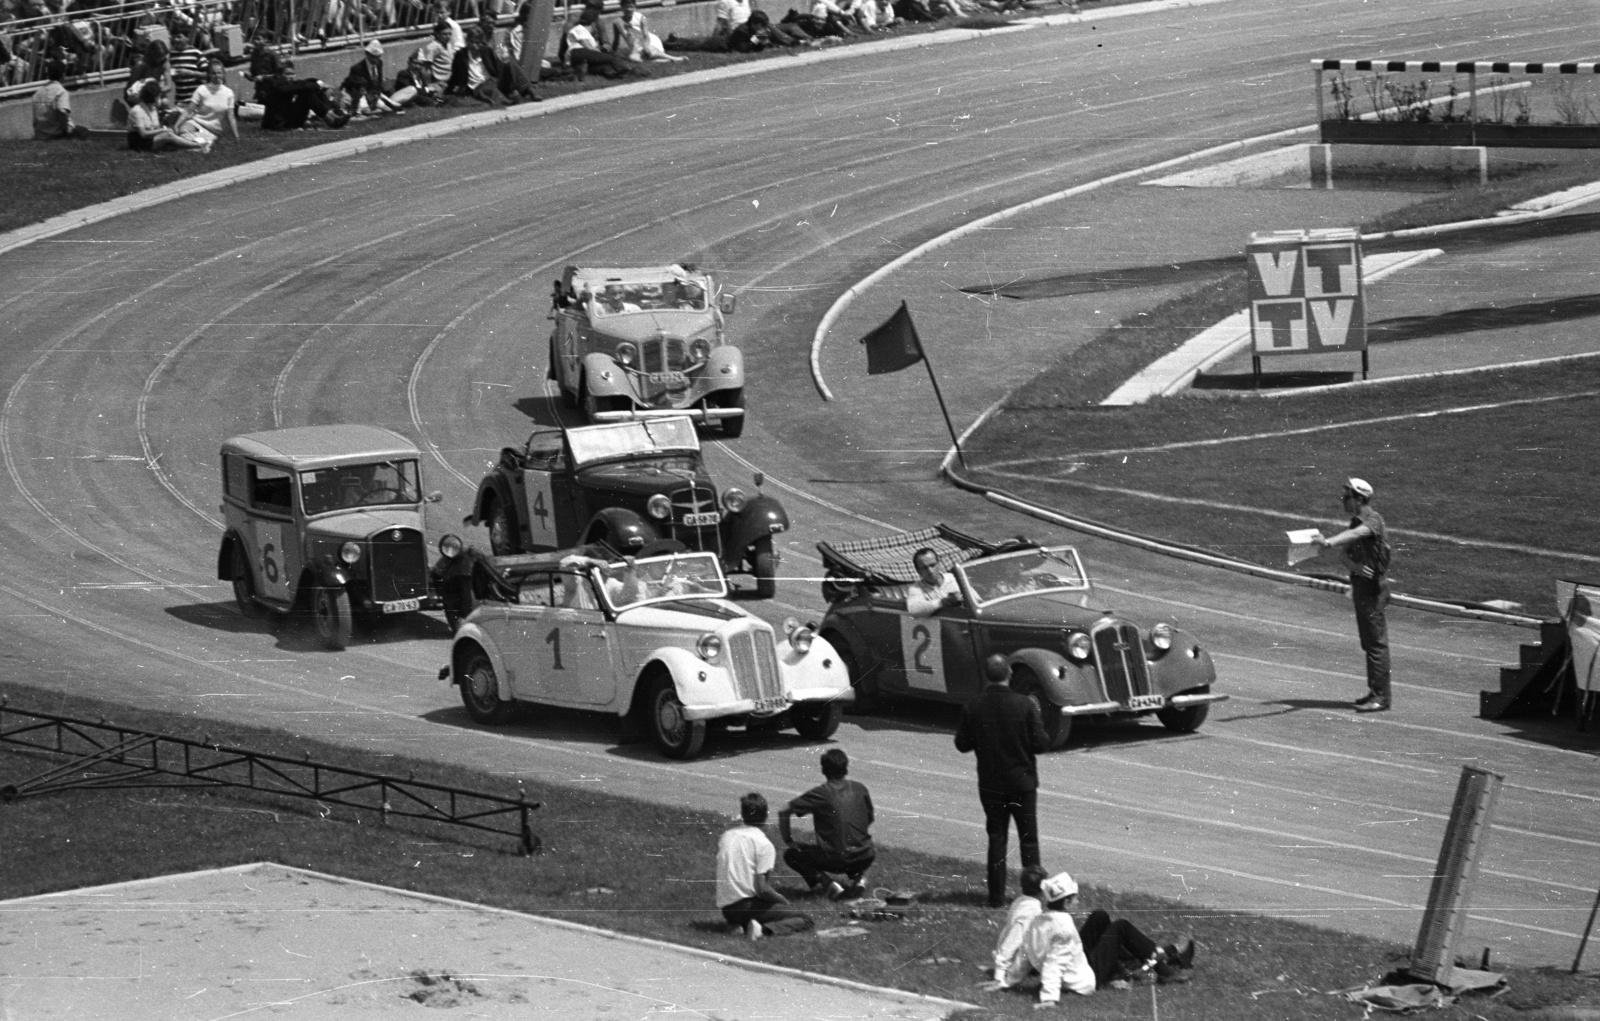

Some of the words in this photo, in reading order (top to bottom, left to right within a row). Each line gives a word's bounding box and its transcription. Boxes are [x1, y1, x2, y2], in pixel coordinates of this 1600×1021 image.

[533, 491, 549, 531] 4
[263, 543, 279, 583] 6
[545, 627, 565, 670] 1
[912, 624, 934, 675] 2
